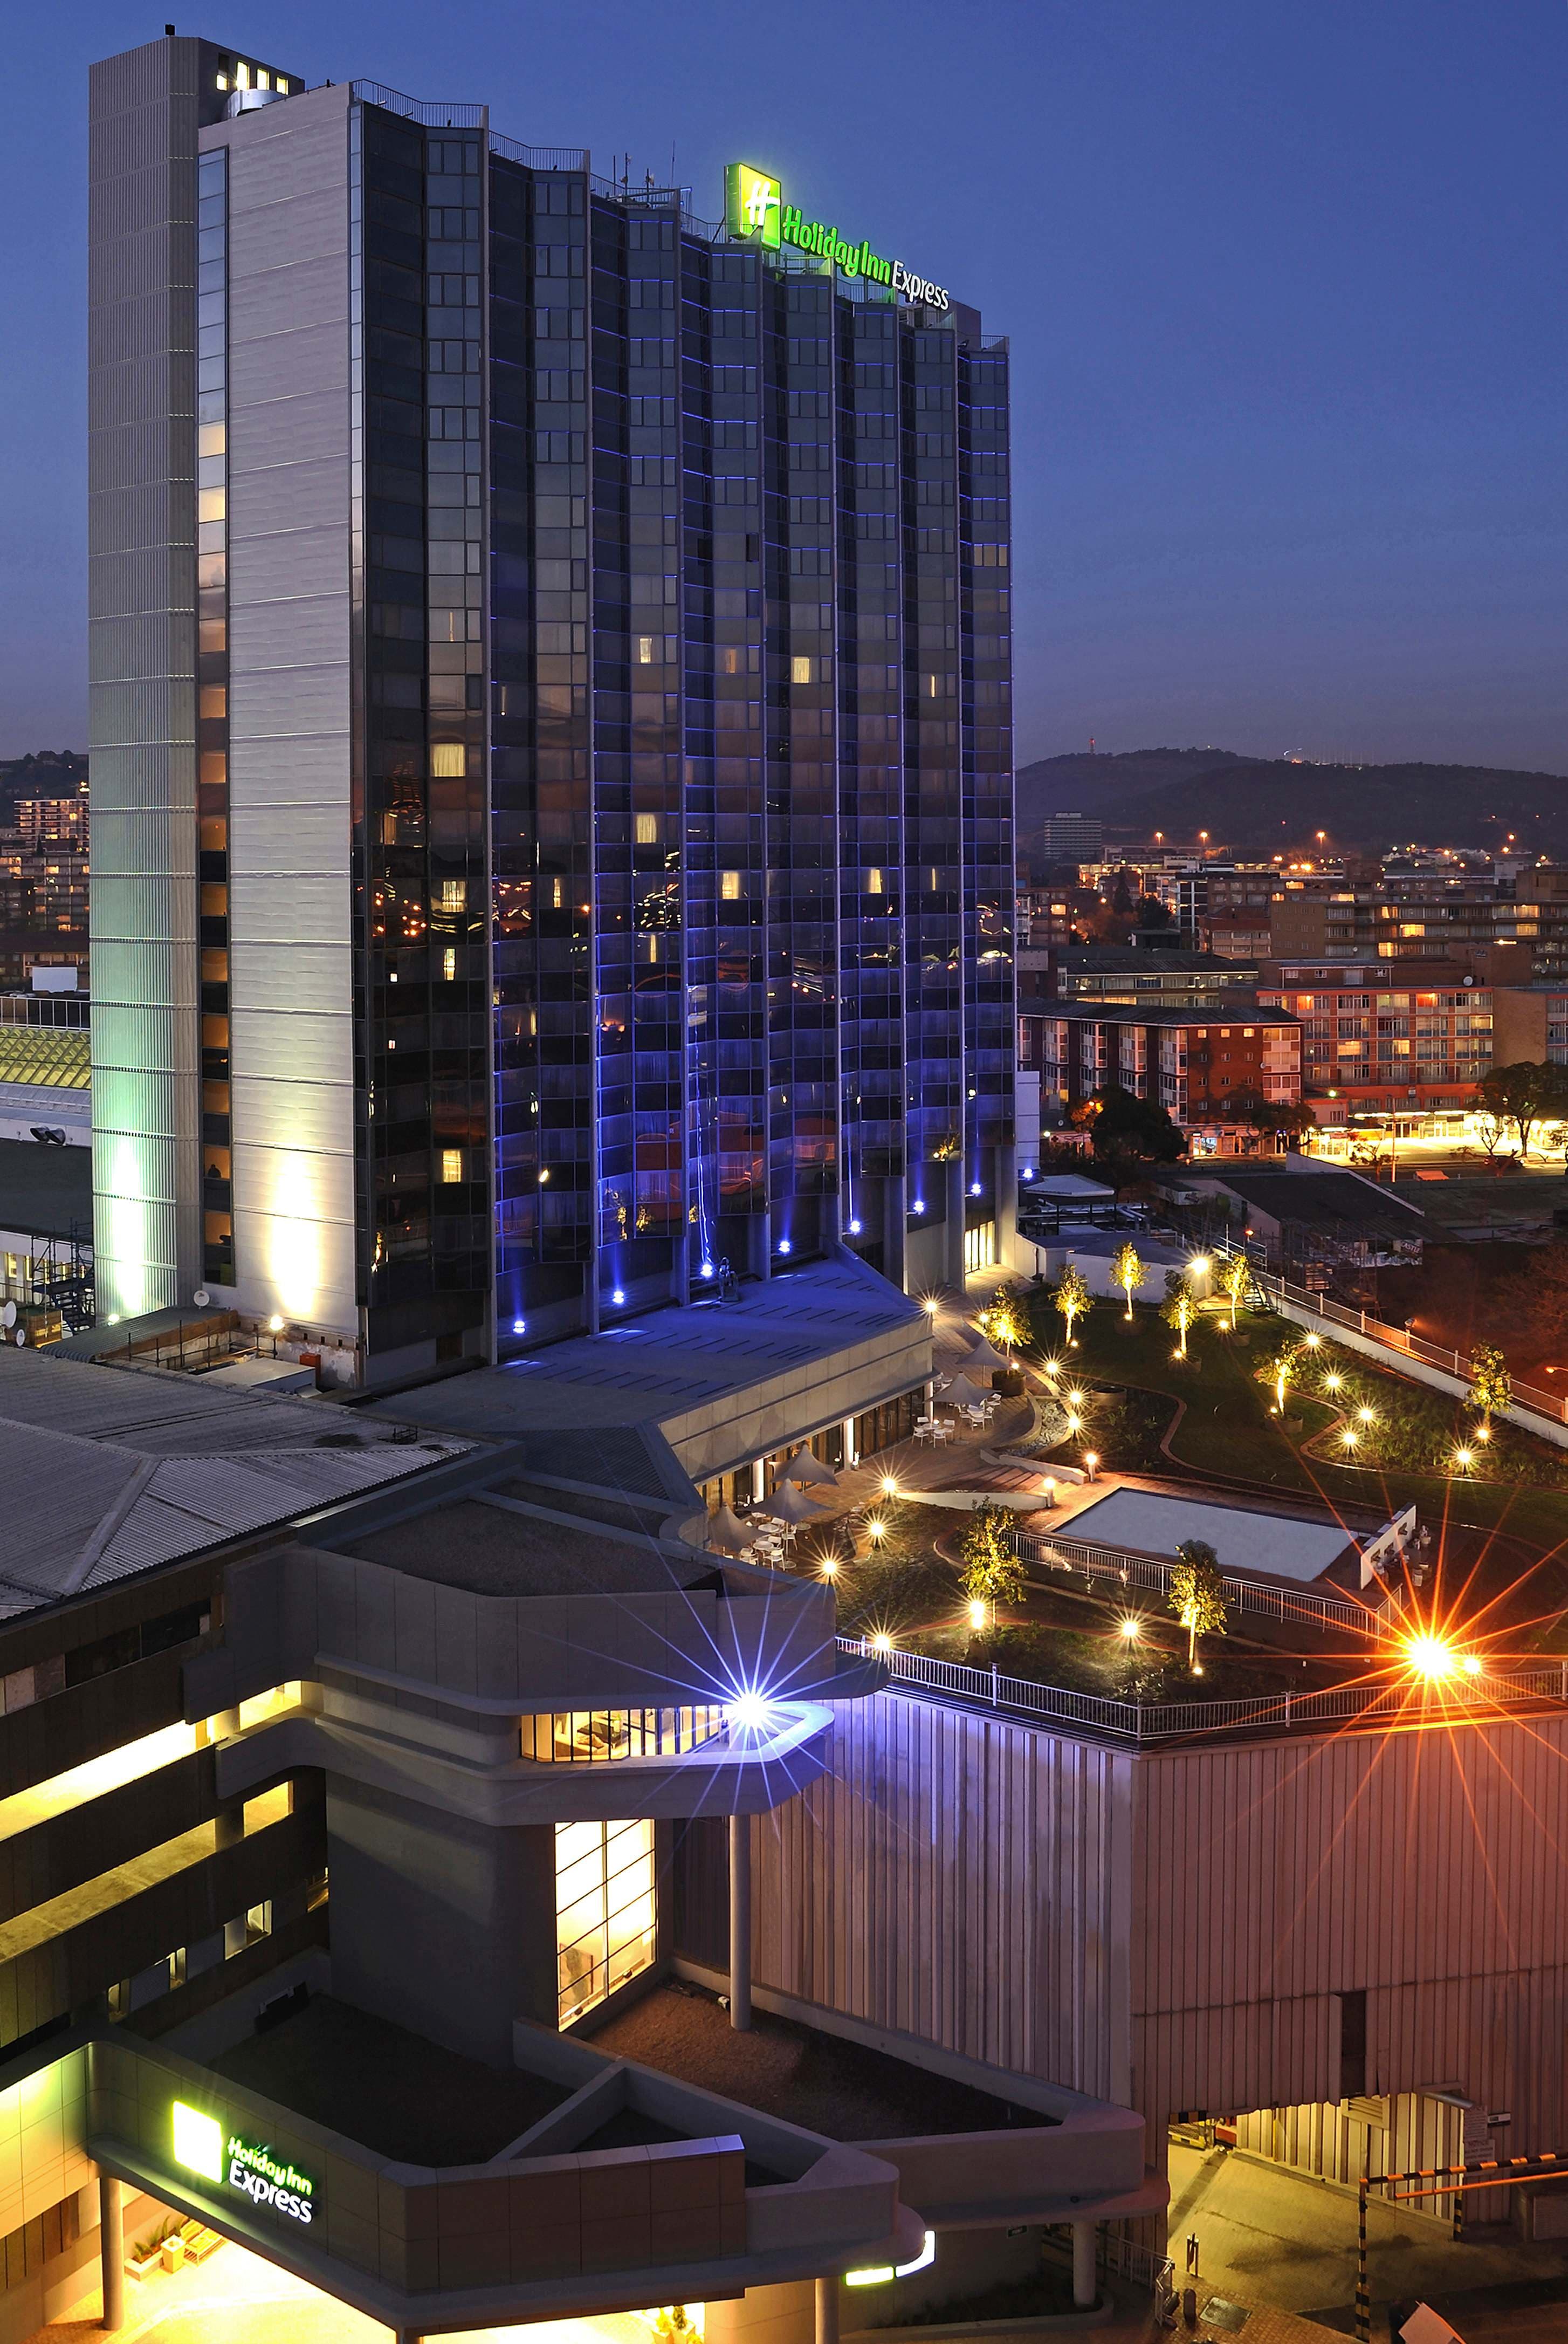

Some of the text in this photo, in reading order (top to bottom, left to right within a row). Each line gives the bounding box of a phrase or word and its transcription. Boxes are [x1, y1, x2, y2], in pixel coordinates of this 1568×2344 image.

[782, 205, 950, 311] Holiday Inn Express
[1402, 1241, 1421, 1253] CASTLE
[227, 2136, 313, 2196] Holiday Inn
[229, 2158, 312, 2223] Express
